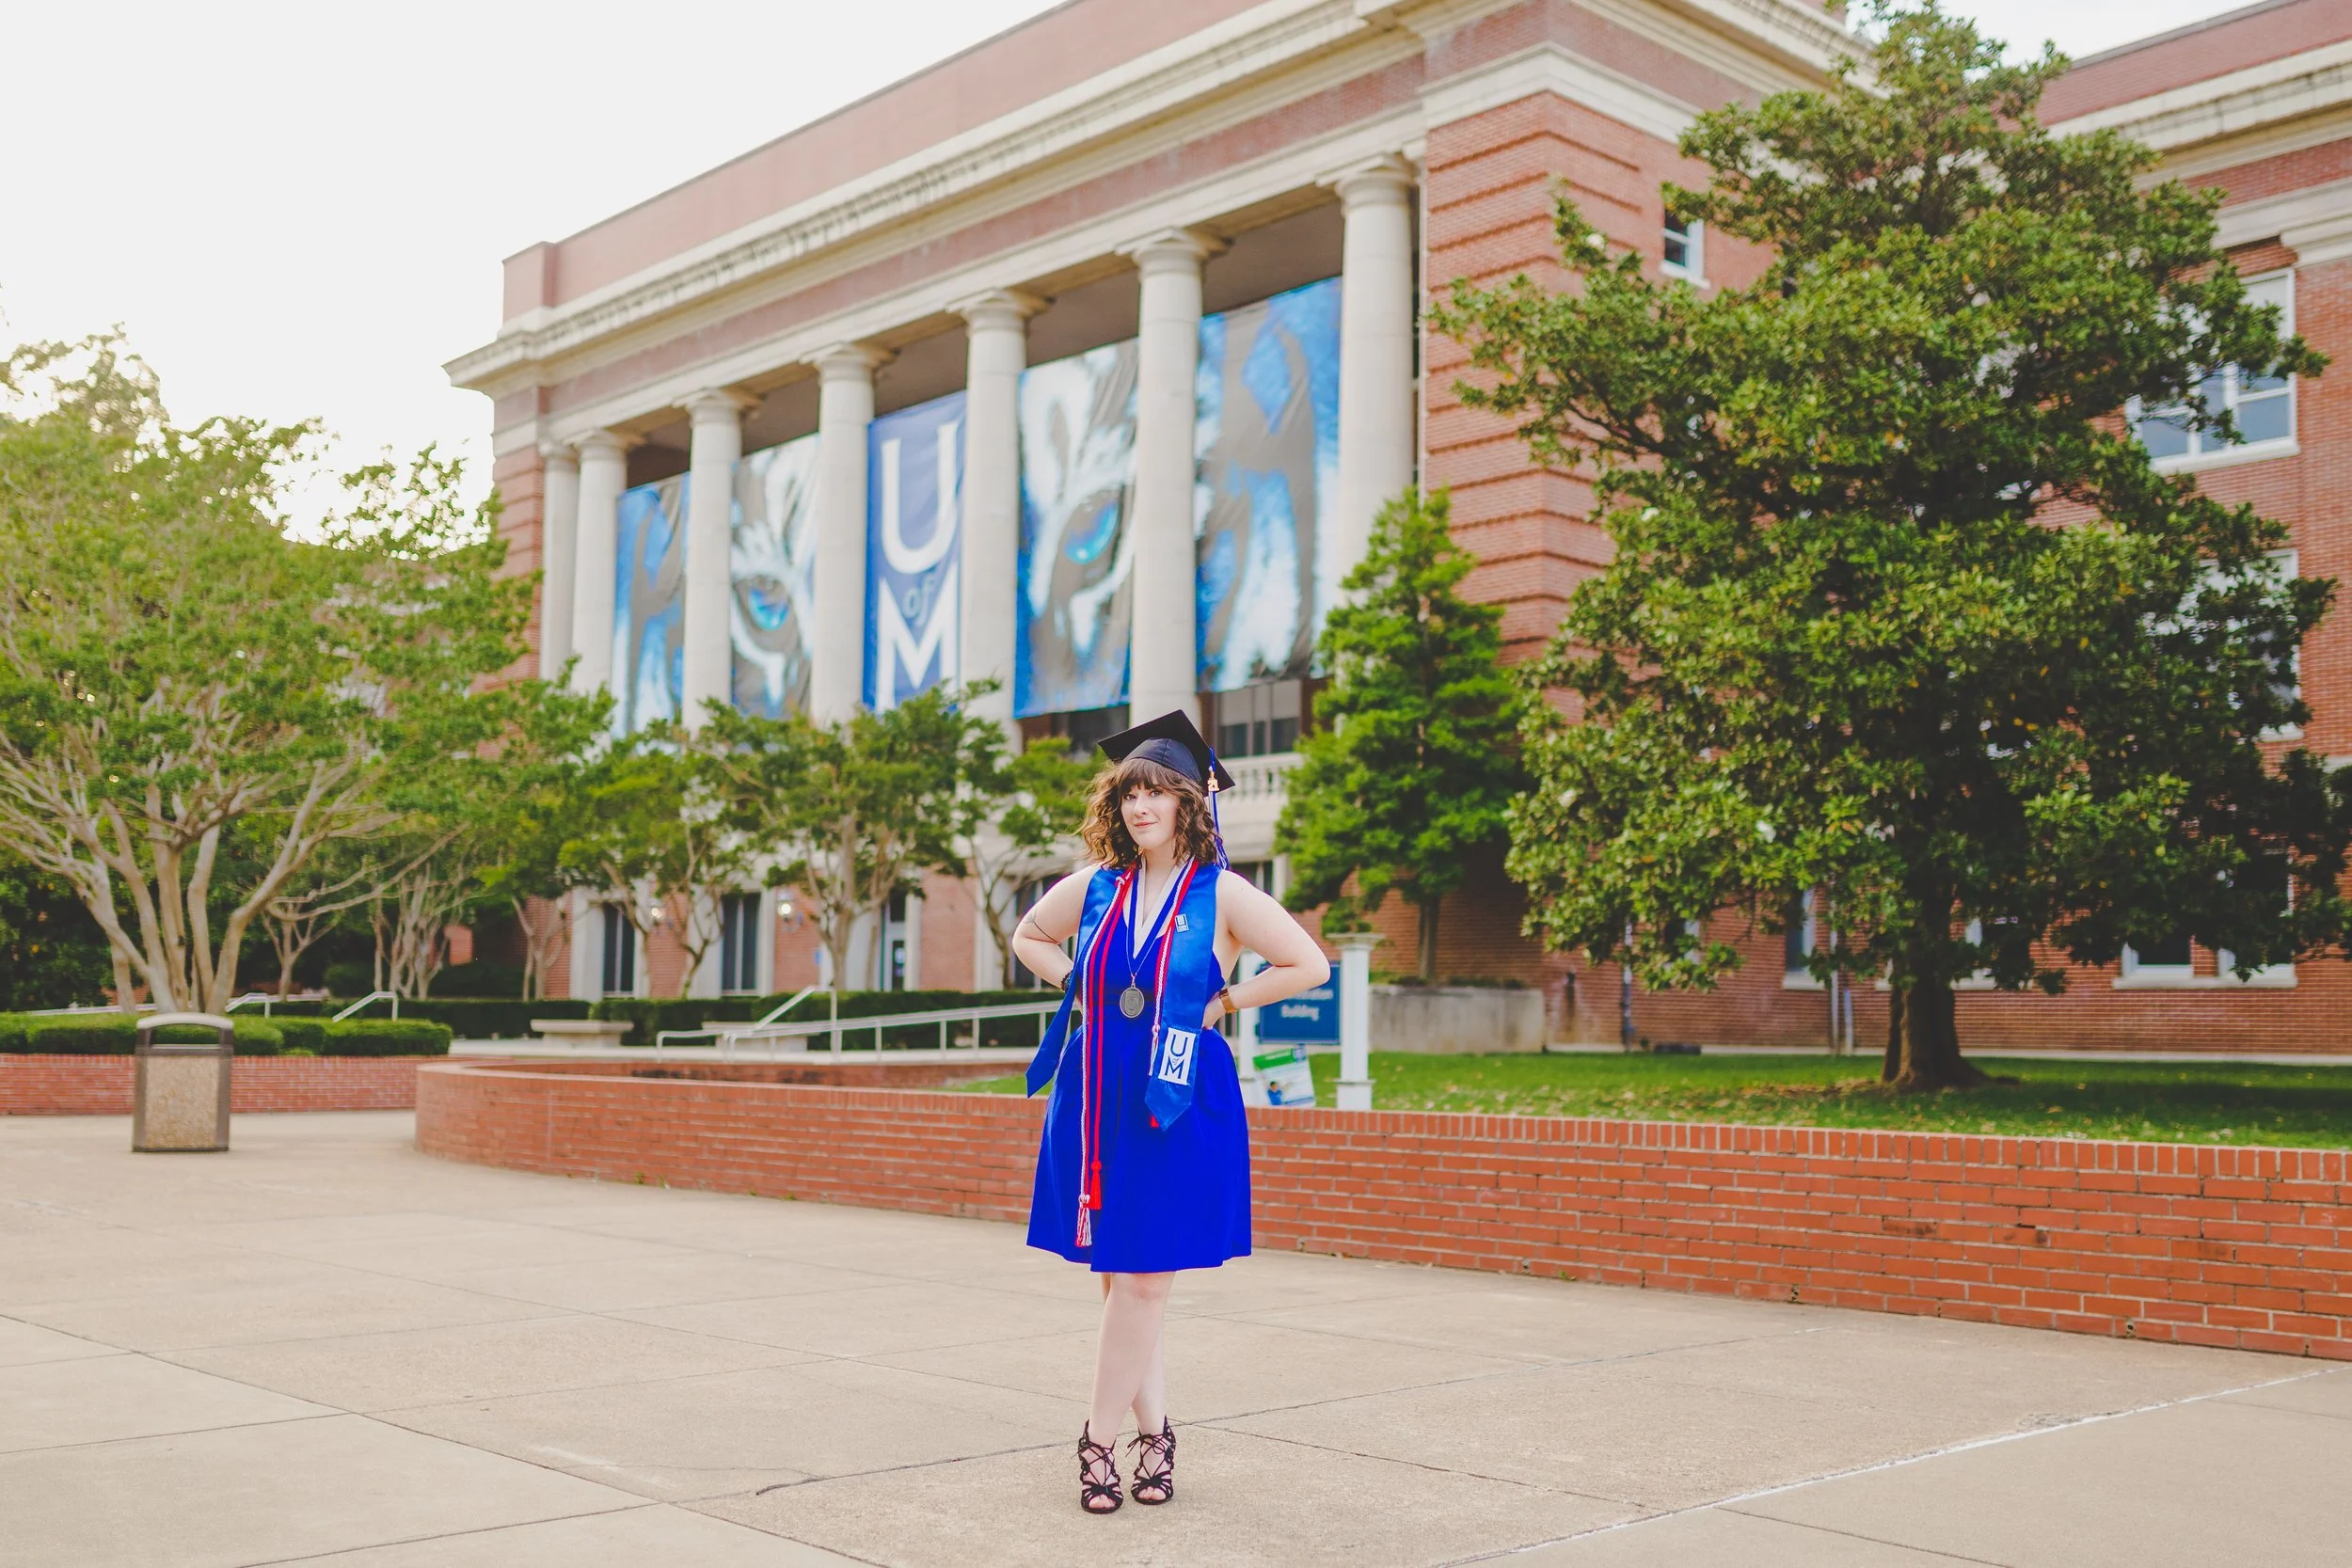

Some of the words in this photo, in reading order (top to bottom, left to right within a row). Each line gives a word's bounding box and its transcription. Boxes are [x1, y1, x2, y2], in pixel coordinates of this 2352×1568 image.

[881, 421, 959, 575] U
[902, 572, 936, 628] of
[876, 564, 959, 712] M
[1169, 1034, 1189, 1057] U
[1171, 1057, 1180, 1066] of
[1165, 1054, 1184, 1080] M
